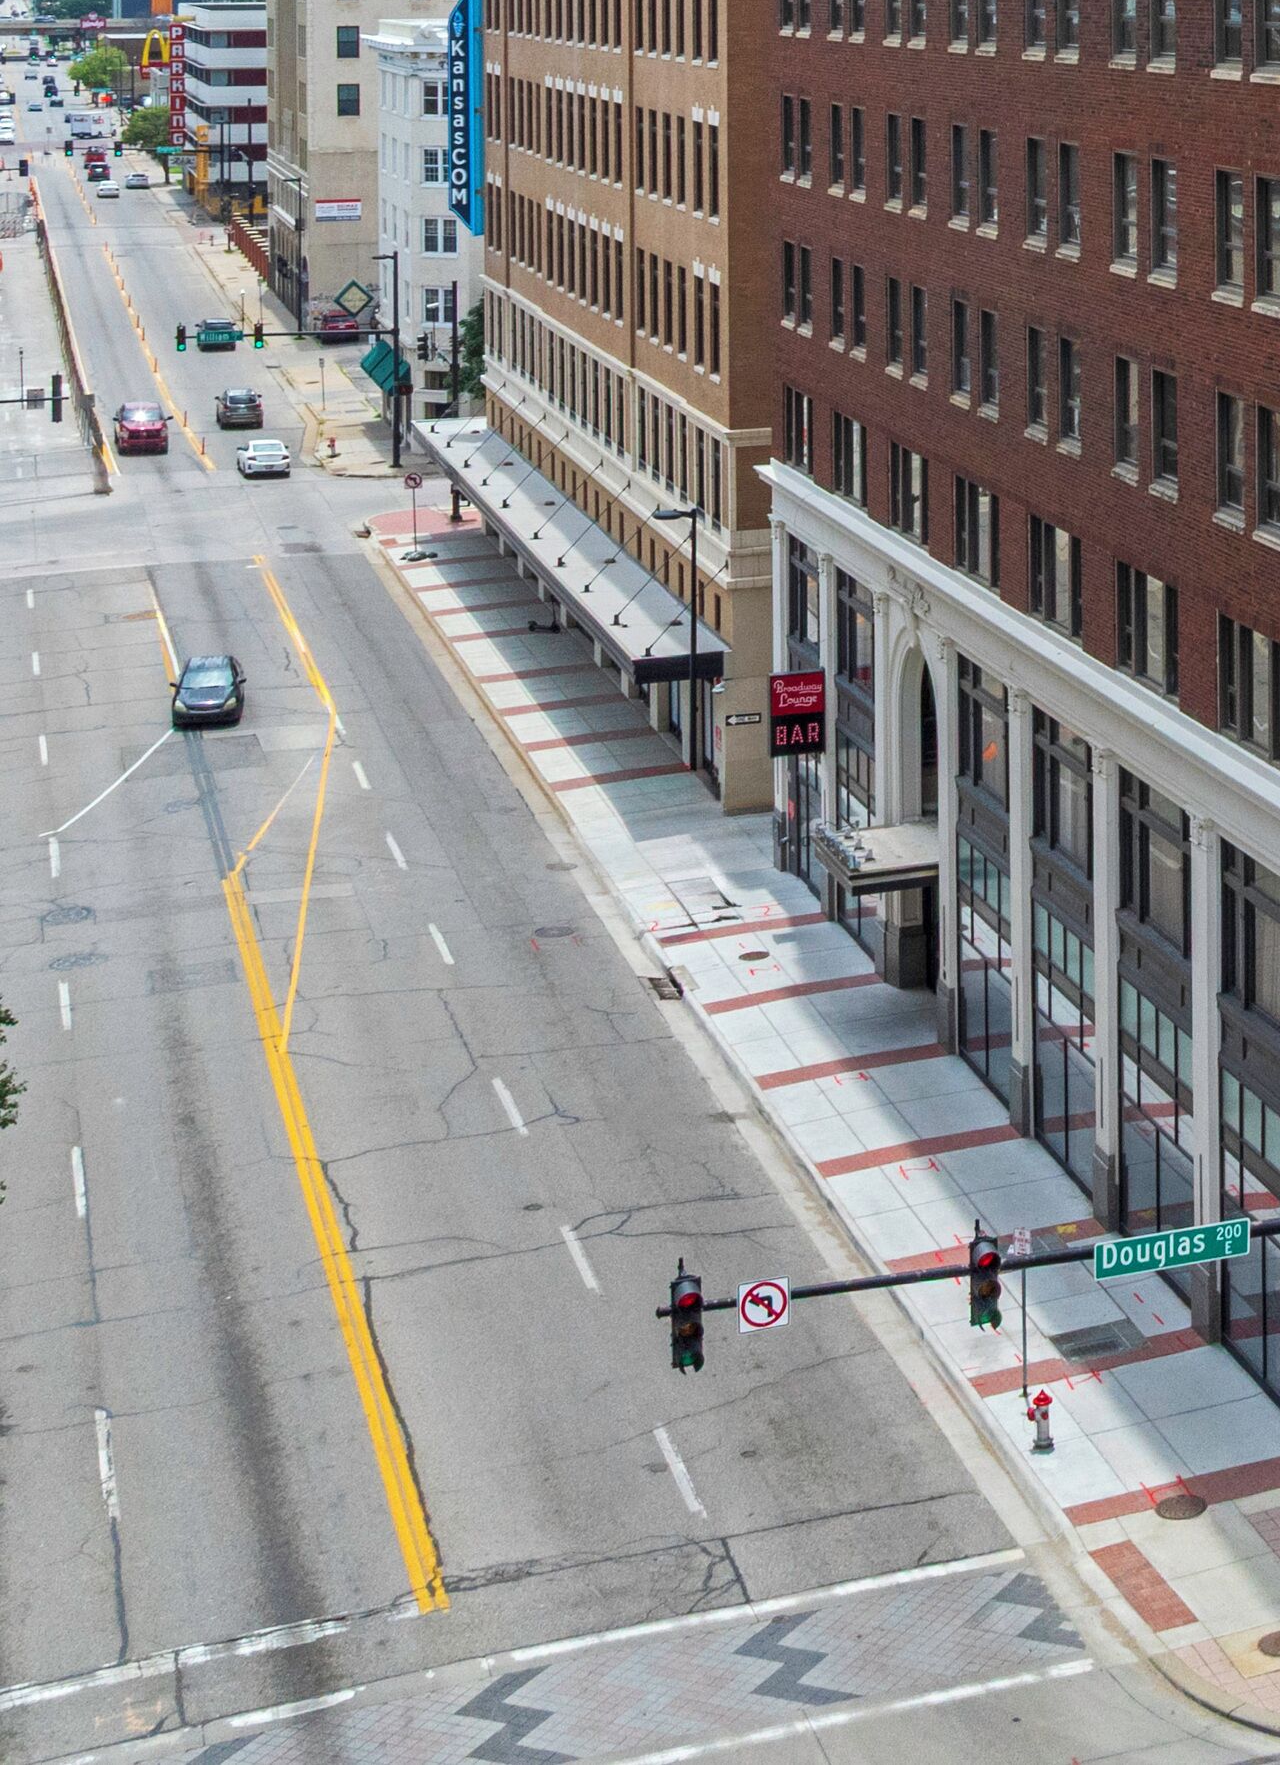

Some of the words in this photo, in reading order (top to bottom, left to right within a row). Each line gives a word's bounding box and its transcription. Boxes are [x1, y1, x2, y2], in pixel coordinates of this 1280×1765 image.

[773, 680, 823, 694] Broadway
[779, 693, 818, 708] Lounge
[776, 722, 820, 746] BAR
[1102, 1233, 1206, 1269] Douglas
[1215, 1223, 1242, 1241] 200
[1224, 1241, 1233, 1255] E
